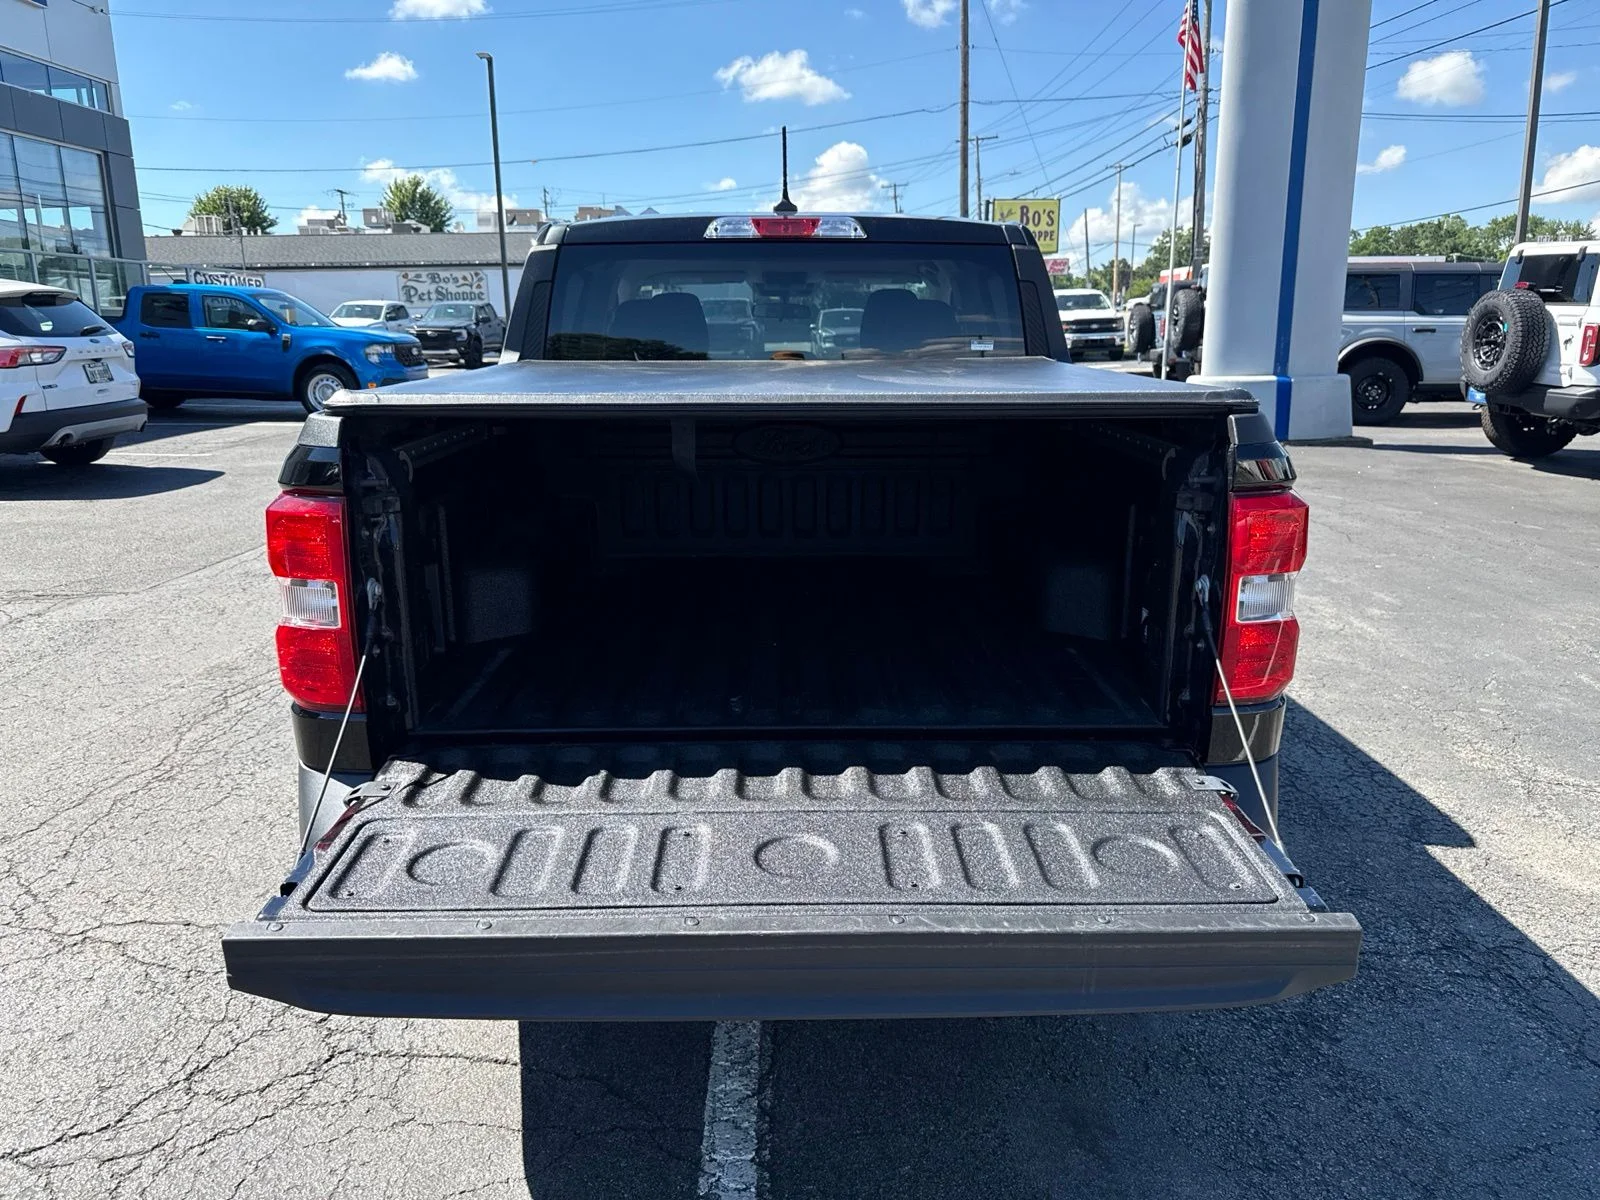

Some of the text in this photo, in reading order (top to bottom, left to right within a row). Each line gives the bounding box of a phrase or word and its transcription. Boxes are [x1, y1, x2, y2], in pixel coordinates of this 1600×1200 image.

[1019, 205, 1055, 227] BO'S
[193, 271, 263, 288] CUSTOMER
[426, 272, 460, 284] Bo's
[401, 285, 486, 303] Pet Shoppe
